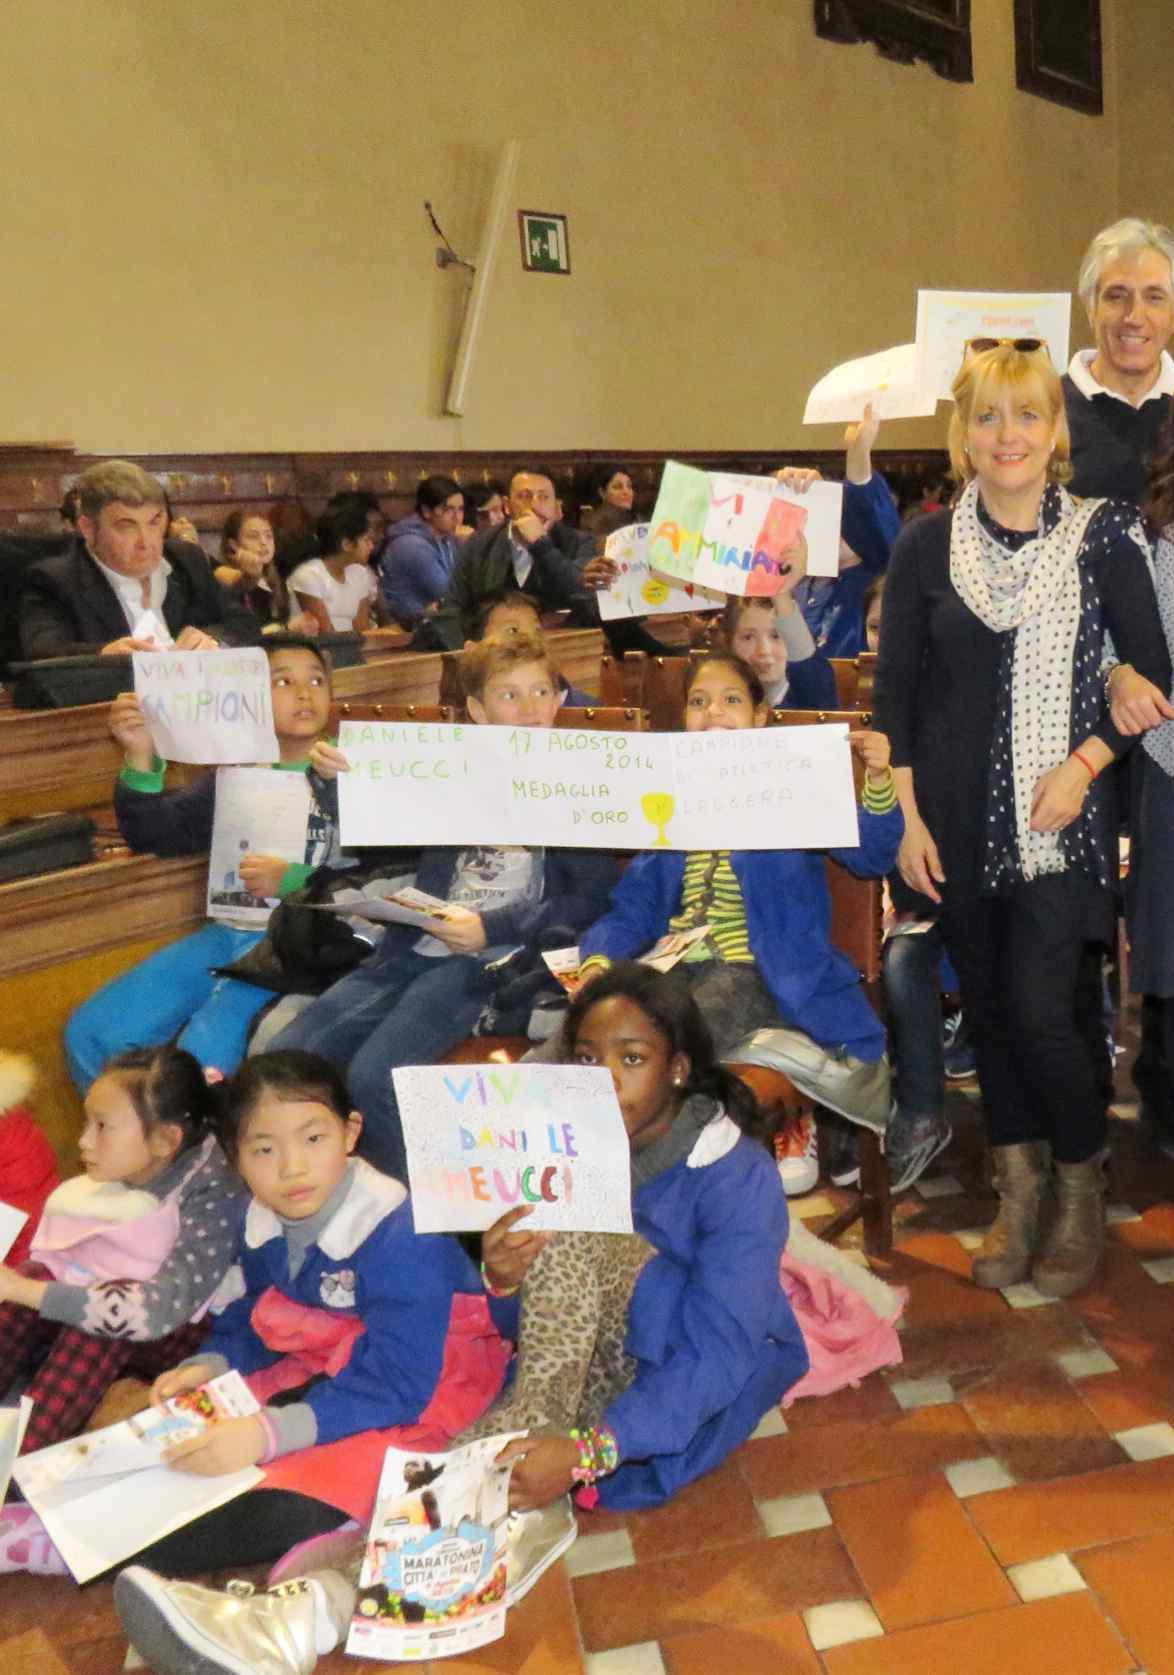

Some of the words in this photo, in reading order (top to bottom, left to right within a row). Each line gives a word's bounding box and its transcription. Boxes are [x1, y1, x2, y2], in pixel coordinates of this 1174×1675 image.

[341, 724, 465, 746] DANIELE
[508, 730, 531, 755] 17
[548, 731, 628, 752] AGOSTO
[605, 753, 655, 769] 2014
[511, 776, 610, 799] MEDAGLIA
[572, 808, 630, 825] D'ORO
[446, 1165, 574, 1207] MEUCCI
